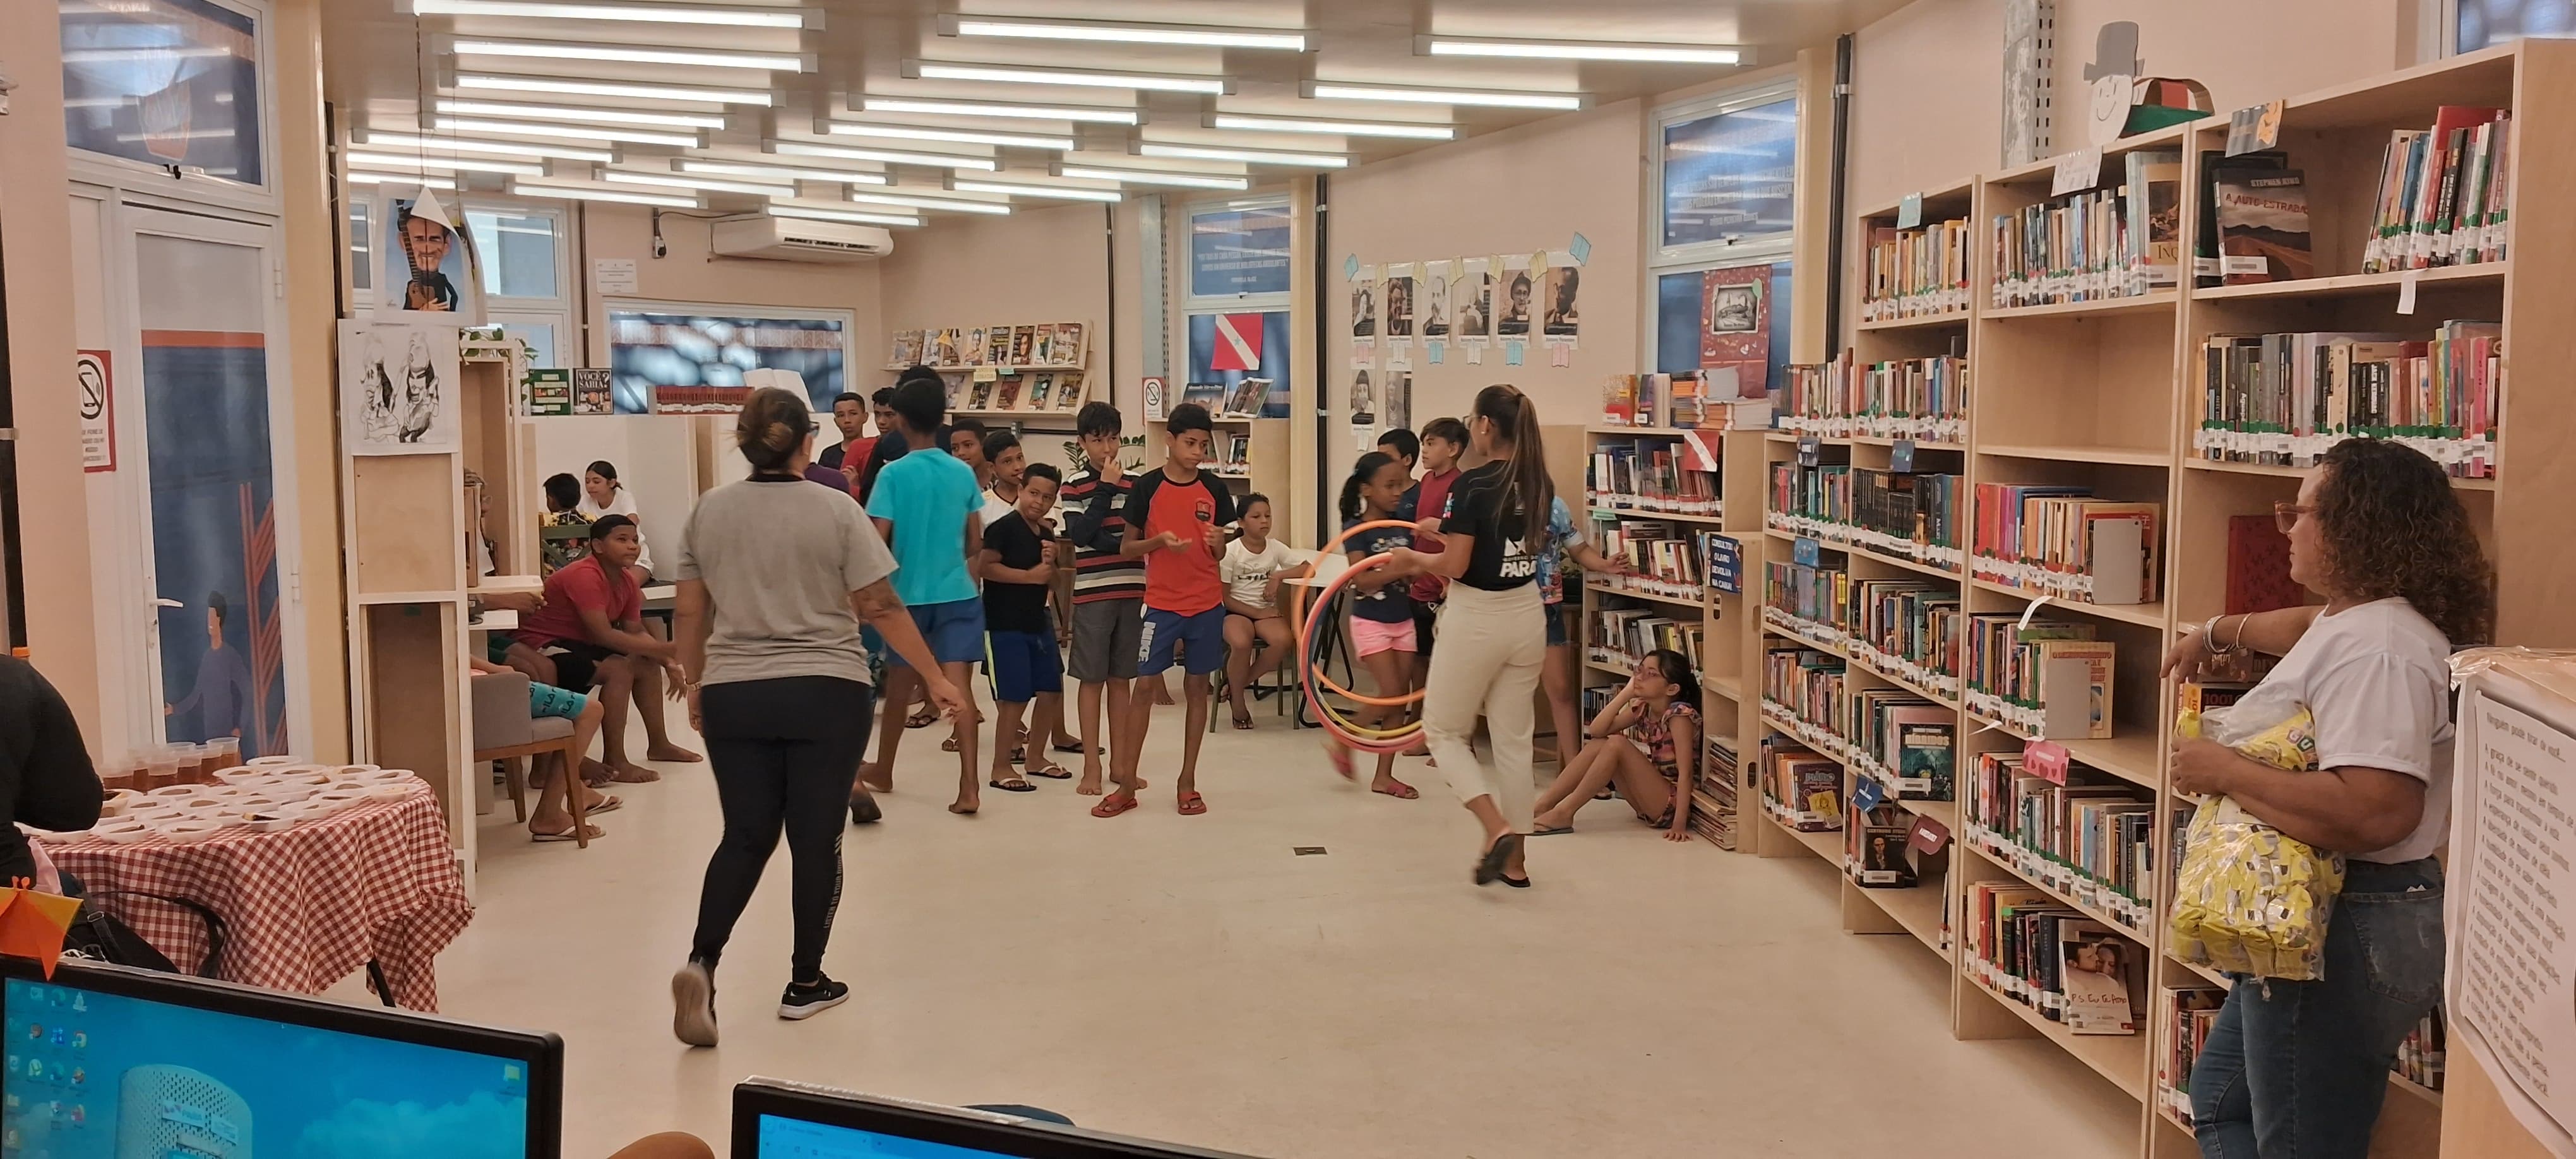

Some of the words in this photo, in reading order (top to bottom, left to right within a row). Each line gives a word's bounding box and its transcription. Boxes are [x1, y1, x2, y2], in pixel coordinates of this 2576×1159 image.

[2250, 177, 2281, 187] STEPHEN
[1717, 553, 1730, 563] LIVRO
[1712, 565, 1731, 577] DEVOLVA
[1138, 622, 1157, 662] NIKE
